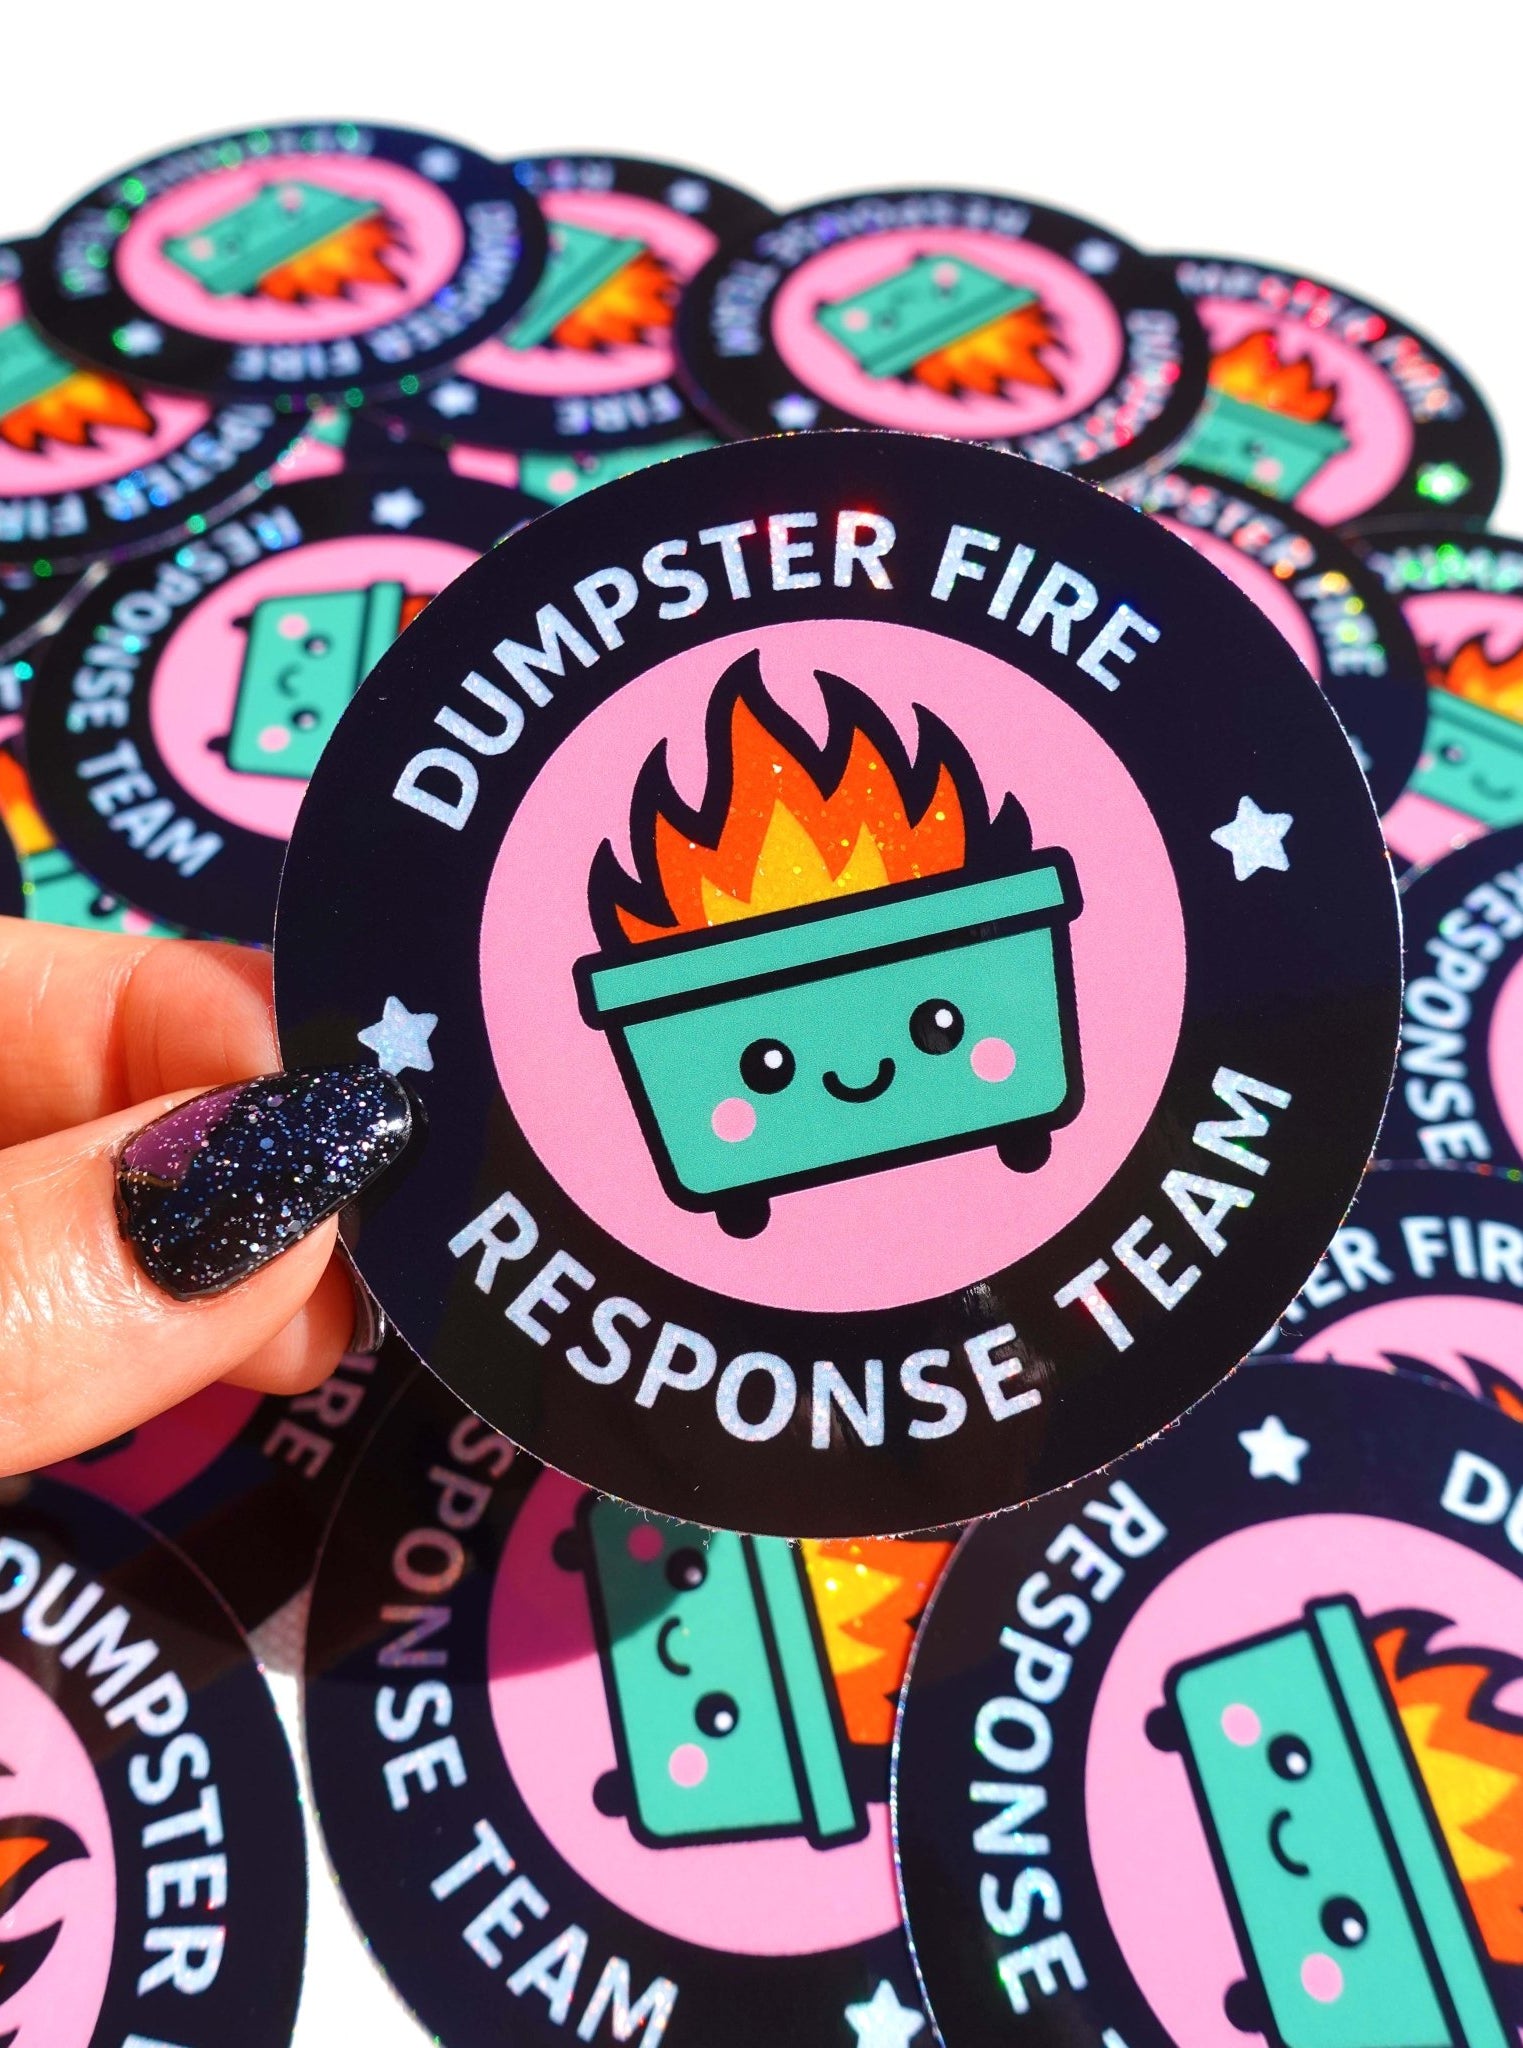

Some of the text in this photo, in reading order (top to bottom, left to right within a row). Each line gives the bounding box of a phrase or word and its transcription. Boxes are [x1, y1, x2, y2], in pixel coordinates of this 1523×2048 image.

[67, 506, 301, 878] RESPONSE TEAM
[393, 511, 1160, 830] DUMPSTER FIRE
[448, 1066, 1291, 1449] RESPONSE TEAM
[0, 1537, 228, 1996] DUMPSTER
[429, 1818, 678, 2048] TEAM
[969, 1480, 1168, 2015] RESPONSE
